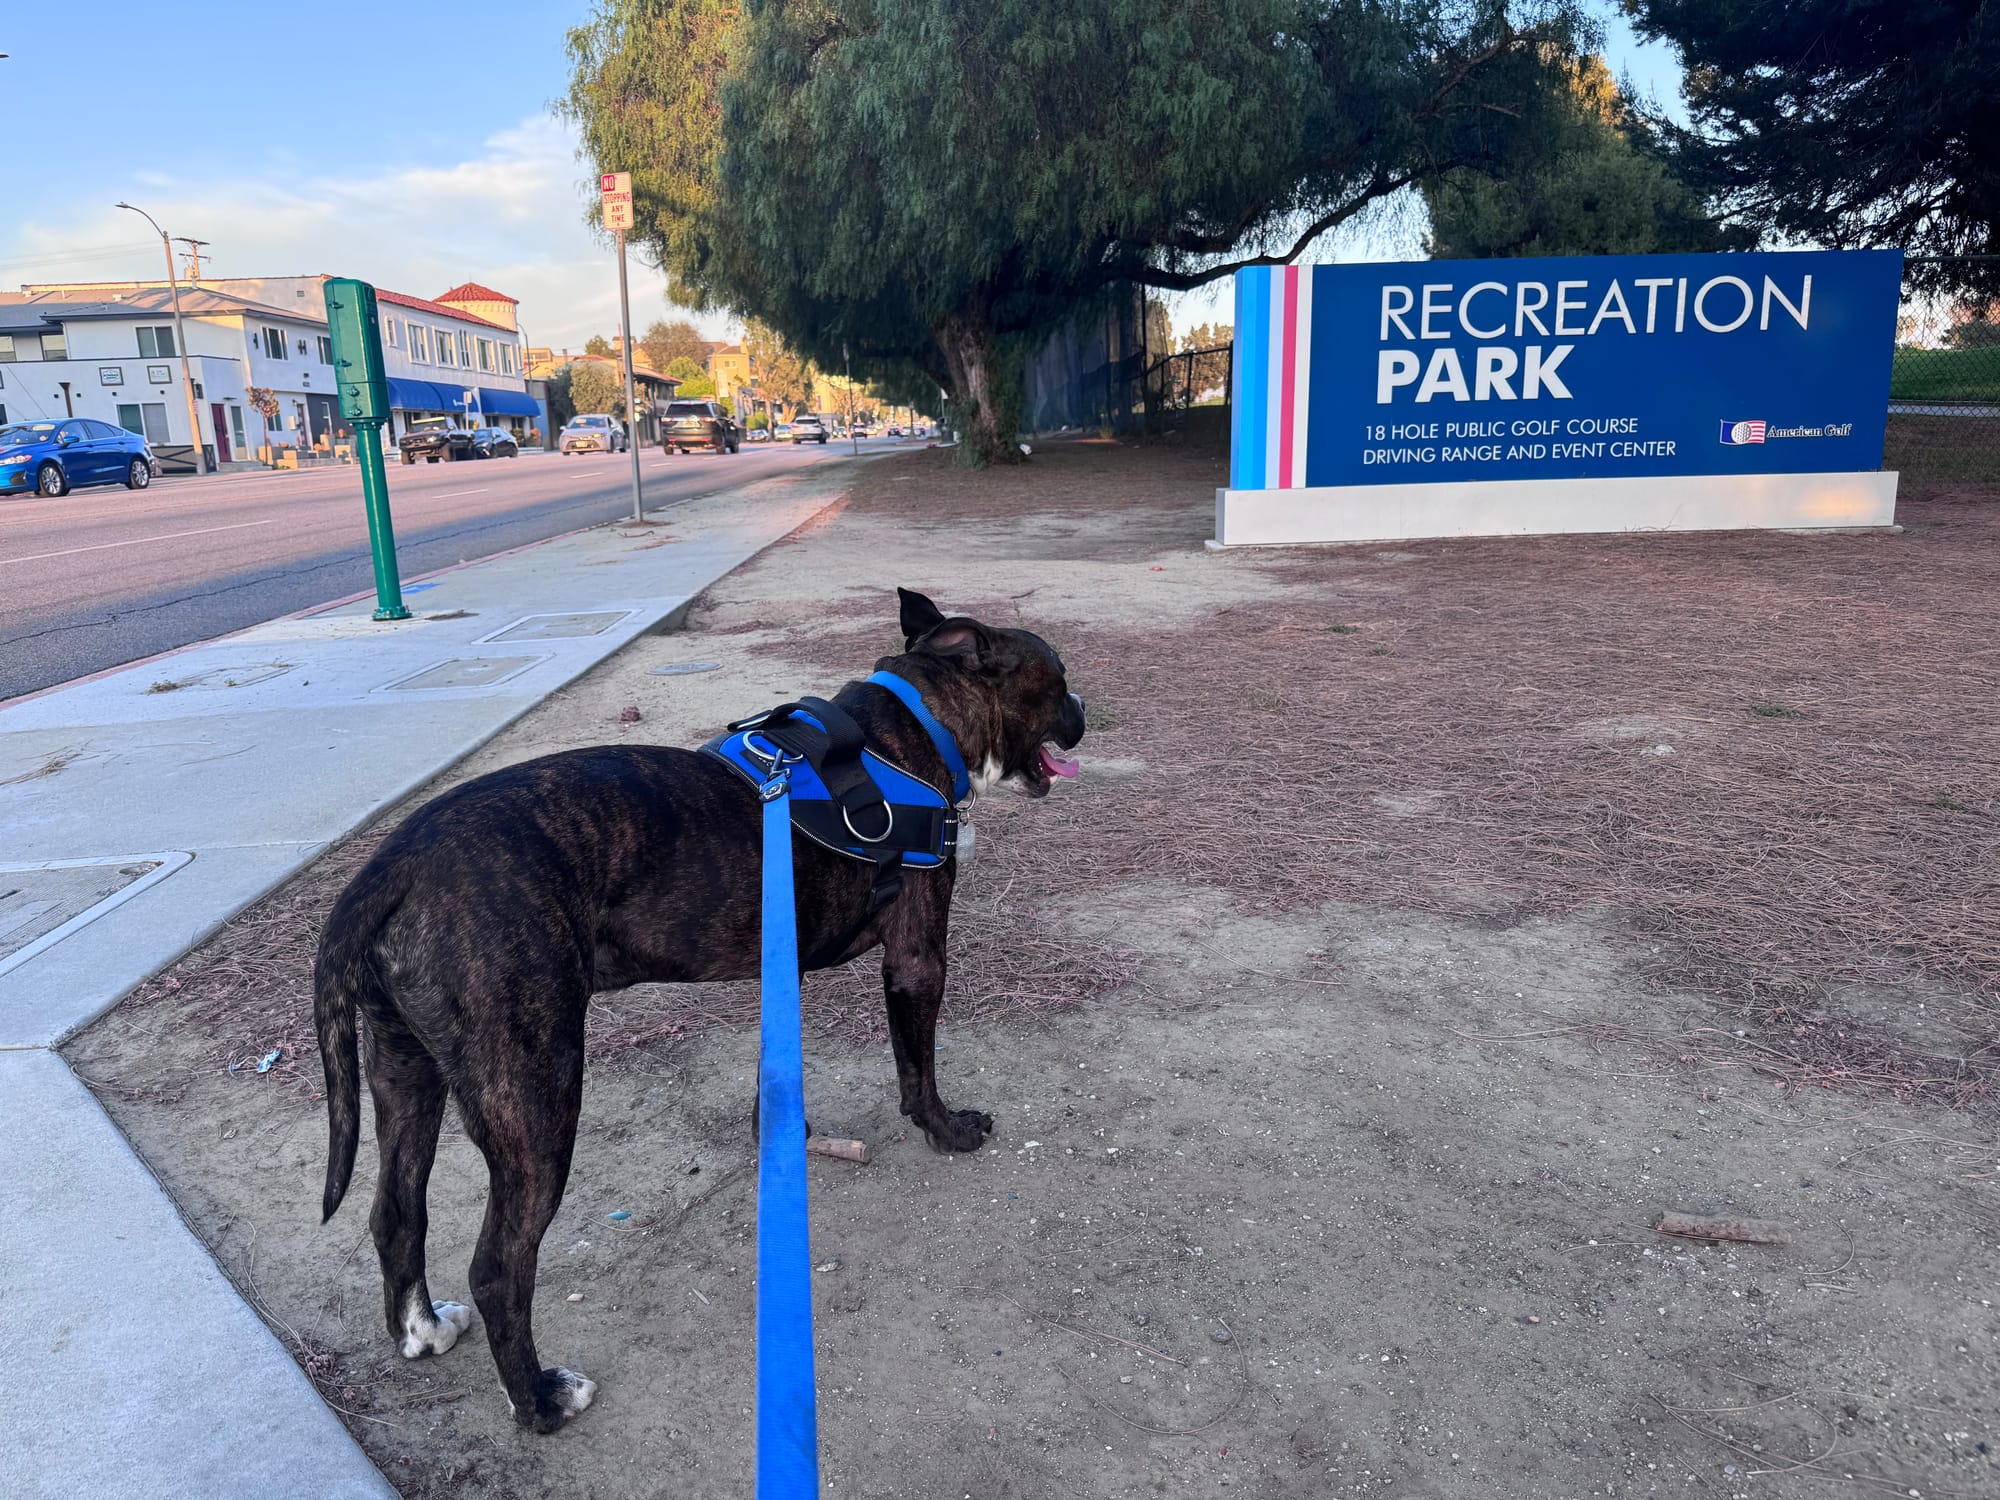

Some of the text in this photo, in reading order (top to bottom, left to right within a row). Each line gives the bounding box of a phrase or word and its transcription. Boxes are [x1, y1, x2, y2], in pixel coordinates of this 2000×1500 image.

[603, 176, 614, 190] NO
[612, 205, 623, 213] ANY
[612, 214, 624, 223] TIME
[1379, 274, 1813, 341] RECREATION
[1376, 344, 1576, 404] PARK
[1365, 418, 1639, 441] 18 HOLE PUBLIC GOLF COURSE
[1766, 423, 1852, 438] American Golf
[1363, 440, 1677, 465] DRIVING RANGE AND EVENT CENTER
